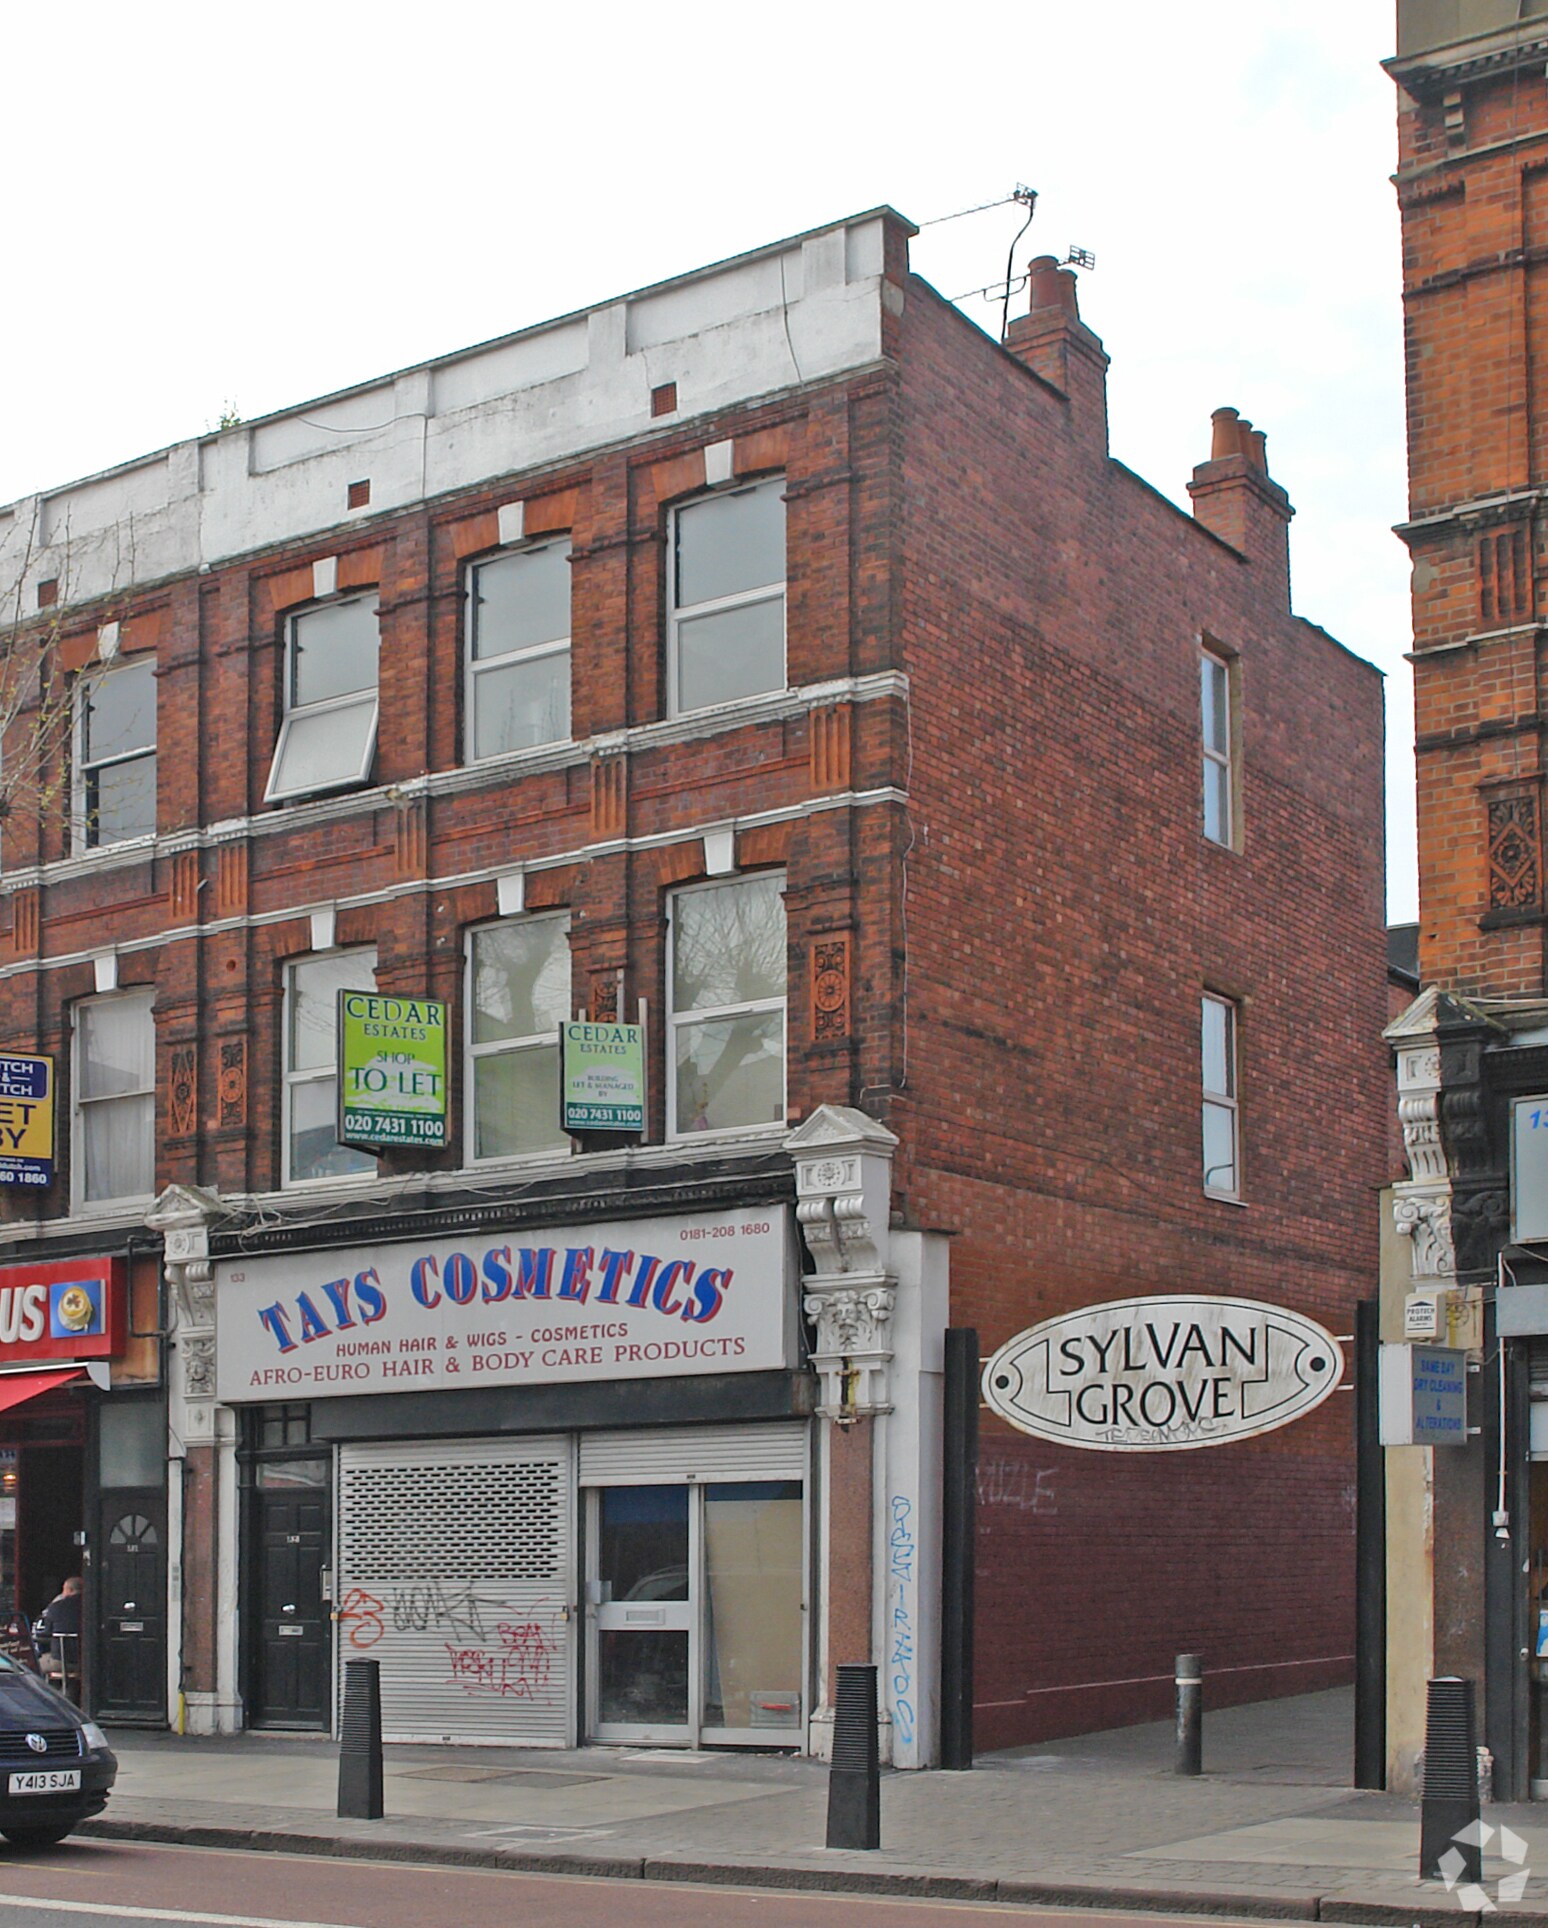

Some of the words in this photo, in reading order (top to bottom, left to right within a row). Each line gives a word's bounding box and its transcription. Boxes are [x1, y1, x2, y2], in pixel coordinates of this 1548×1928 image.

[346, 997, 441, 1025] CEDAR
[364, 1023, 426, 1040] ESTATES
[568, 1025, 637, 1043] CEDAR
[580, 1044, 626, 1054] ESTATES
[377, 1051, 415, 1065] SHOP
[0, 1060, 34, 1074] TCH
[349, 1066, 387, 1092] TO
[399, 1071, 442, 1096] LET
[595, 1082, 634, 1090] MANAGED
[567, 1107, 588, 1120] 020
[590, 1109, 613, 1121] 7431
[616, 1110, 641, 1121] 1100
[345, 1114, 372, 1131] 020
[374, 1117, 406, 1134] 7431
[411, 1119, 444, 1137] 1100
[346, 1132, 444, 1147] www.cedarestates.com
[17, 1173, 47, 1184] 1860
[680, 1225, 735, 1241] 0181-208
[741, 1222, 770, 1236] 1680
[231, 1273, 245, 1283] 133
[257, 1266, 388, 1354] TAYS
[410, 1245, 735, 1324] COSMETICS
[0, 1285, 47, 1343] US
[336, 1341, 391, 1357] HUMAN
[399, 1336, 437, 1353] HAIR
[445, 1335, 458, 1350] &
[467, 1331, 507, 1347] WIGS
[531, 1322, 629, 1343] COSMETICS
[1059, 1322, 1257, 1376] SYLVAN
[249, 1362, 370, 1387] AFRO-EURO
[382, 1356, 434, 1377] HAIR
[445, 1355, 461, 1374] &
[472, 1351, 533, 1372] BODY
[541, 1346, 603, 1367] CARE
[614, 1337, 746, 1363] PRODUCTS
[1421, 1359, 1439, 1373] SAME
[1440, 1361, 1456, 1375] DAY
[1414, 1378, 1428, 1391] DRY
[1430, 1379, 1463, 1393] CLEANING
[1076, 1377, 1236, 1427] GROVE
[1415, 1416, 1463, 1430] ALTERATIONS
[16, 1775, 46, 1790] Y413
[49, 1773, 75, 1788] SJA
